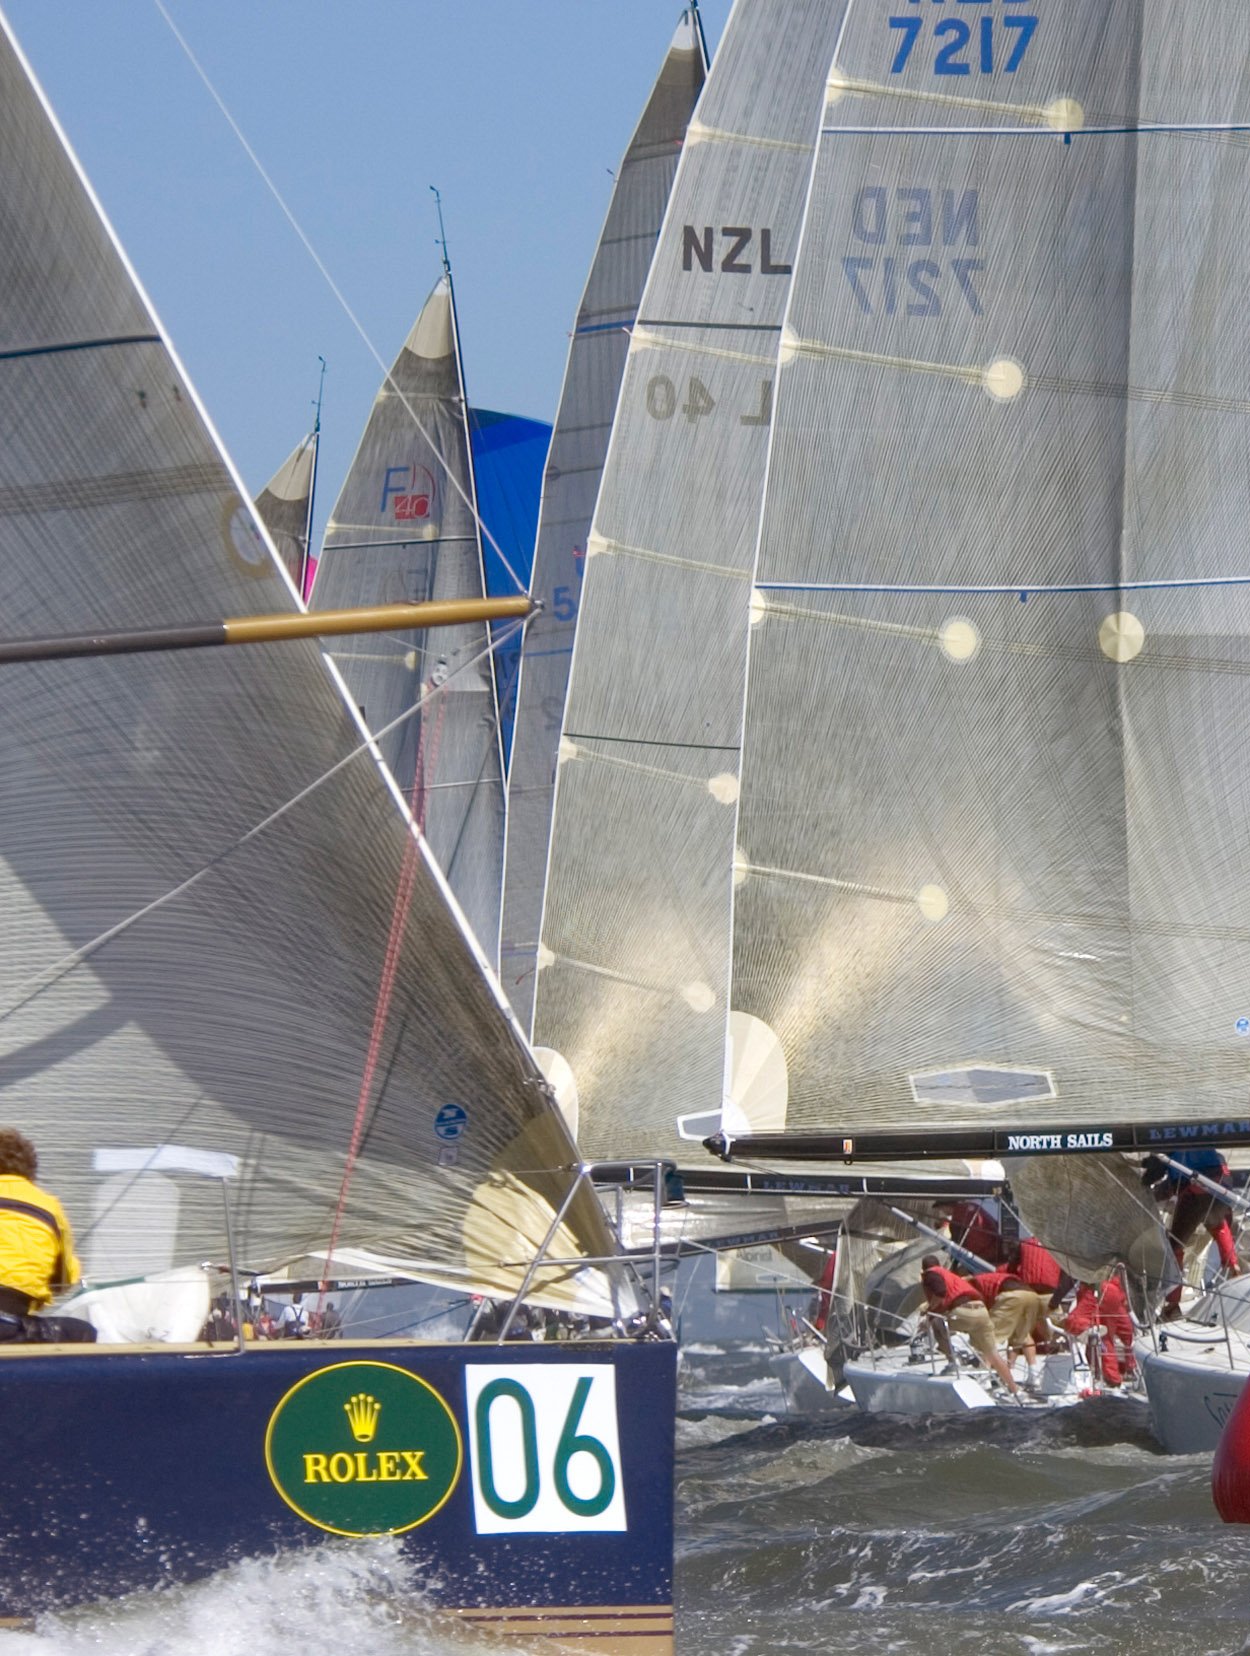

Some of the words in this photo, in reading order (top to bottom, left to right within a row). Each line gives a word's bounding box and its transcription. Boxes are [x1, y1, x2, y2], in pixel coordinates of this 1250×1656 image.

[889, 16, 1039, 75] 7217
[682, 224, 792, 275] NZL
[1008, 1134, 1061, 1151] NORTH
[1067, 1132, 1114, 1148] SAILS
[303, 1451, 429, 1483] ROLEX
[475, 1376, 616, 1520] 06
